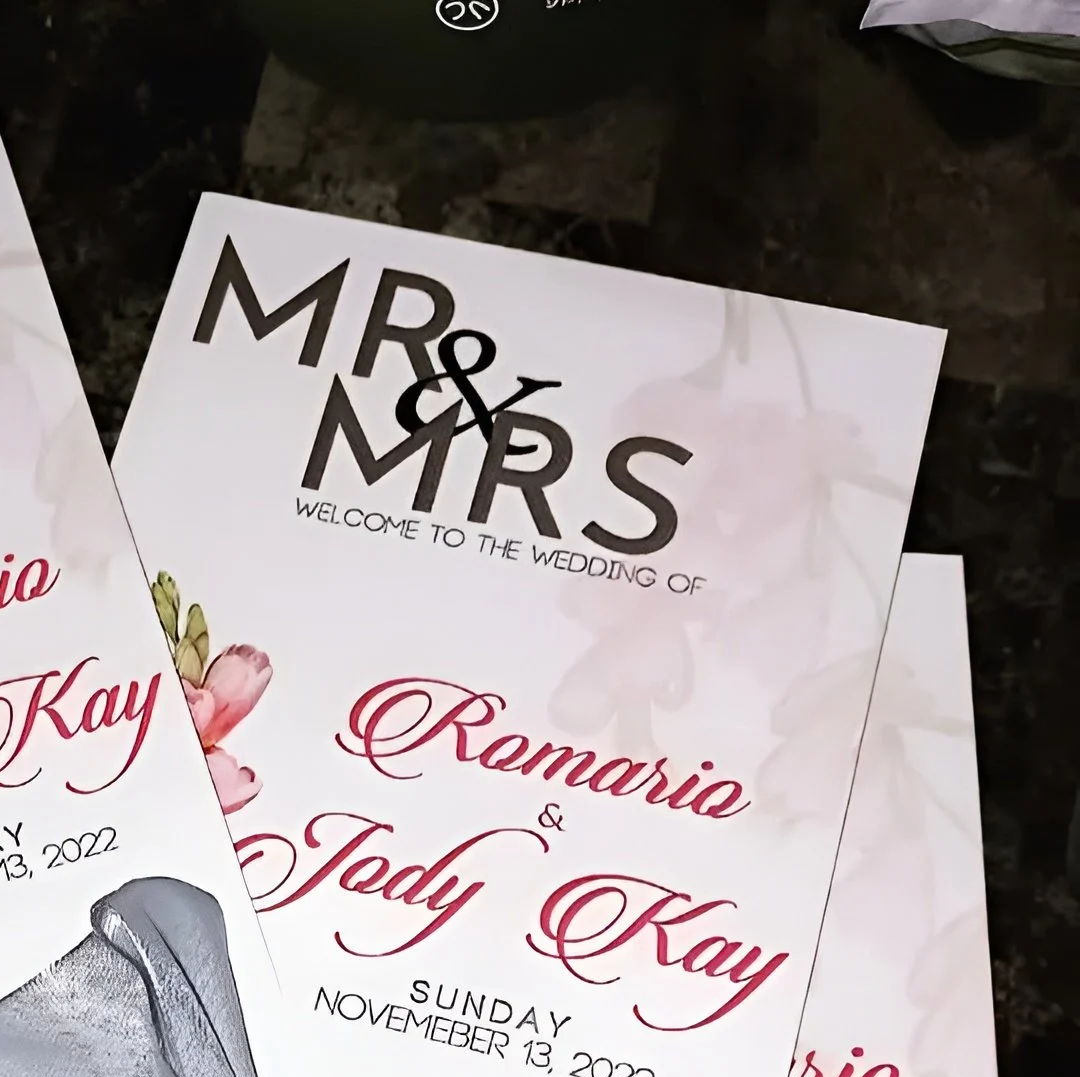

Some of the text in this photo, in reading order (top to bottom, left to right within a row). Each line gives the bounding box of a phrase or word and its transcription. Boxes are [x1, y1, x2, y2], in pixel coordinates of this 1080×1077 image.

[192, 233, 456, 393] MR
[301, 372, 694, 556] MRS
[295, 496, 708, 597] WELCOME TO THE WEDDING OF
[334, 676, 752, 819] Romario
[41, 826, 120, 871] 2022
[537, 802, 567, 833] &
[233, 812, 790, 1032] Jody Kay
[314, 986, 510, 1060] NOVEMEBER
[522, 1040, 554, 1074] 13,
[409, 979, 573, 1040] SUNDAY
